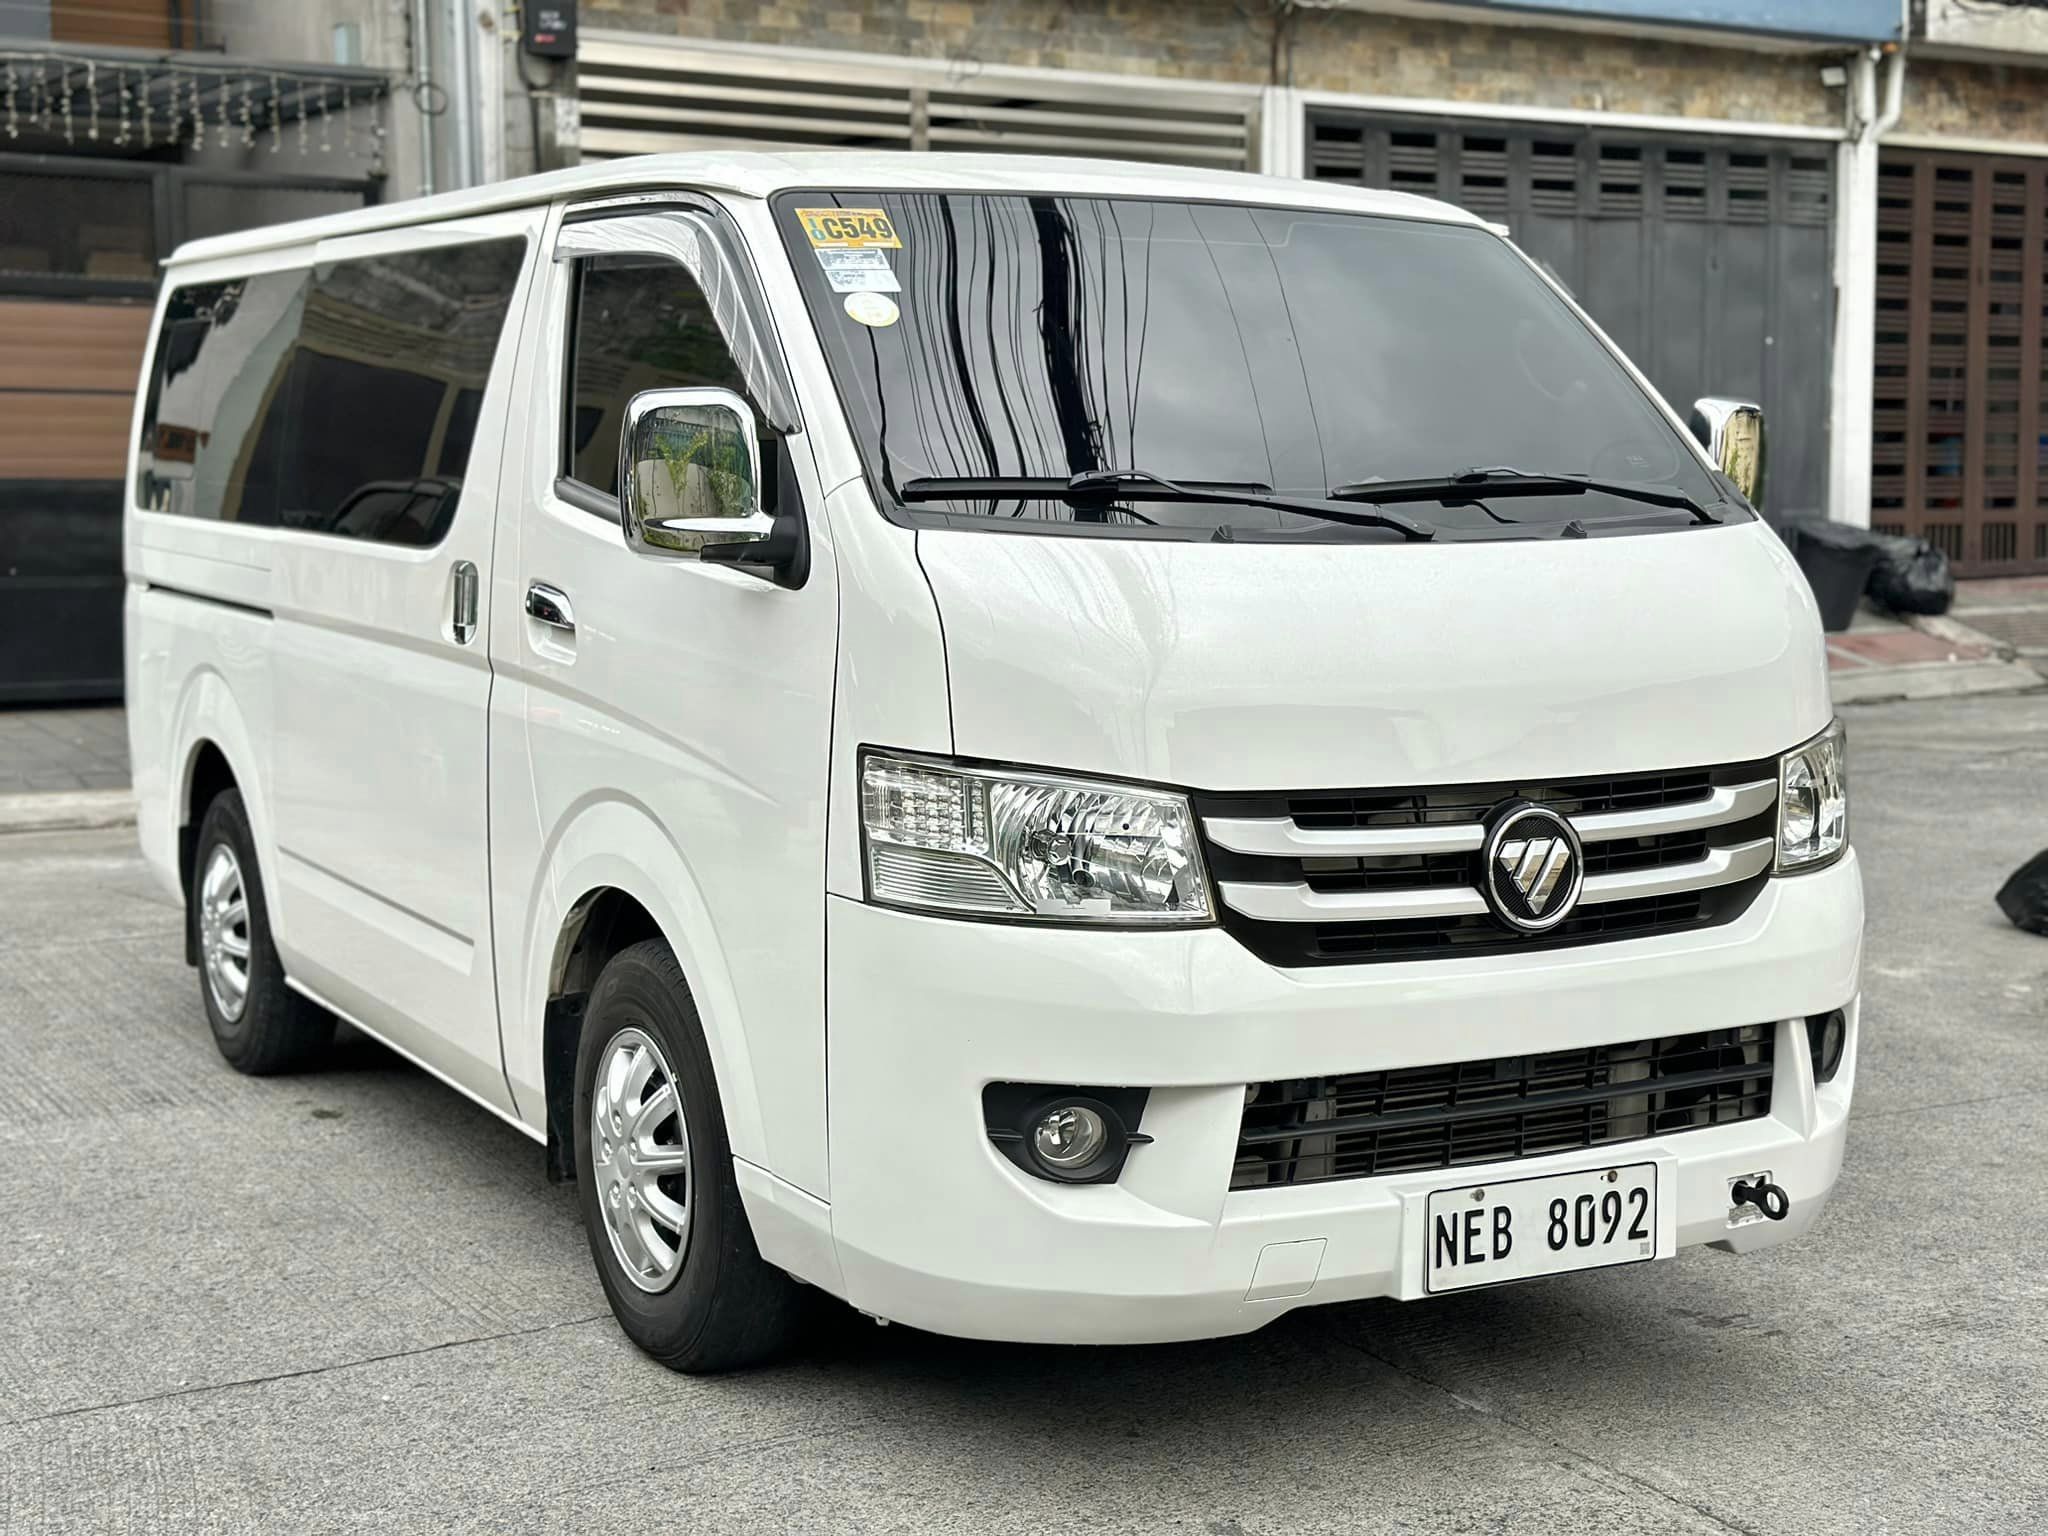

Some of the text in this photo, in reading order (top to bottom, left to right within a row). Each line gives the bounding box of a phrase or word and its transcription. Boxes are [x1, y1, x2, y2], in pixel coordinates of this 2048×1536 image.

[822, 217, 893, 239] C549
[1436, 1187, 1649, 1269] NEB 8092
